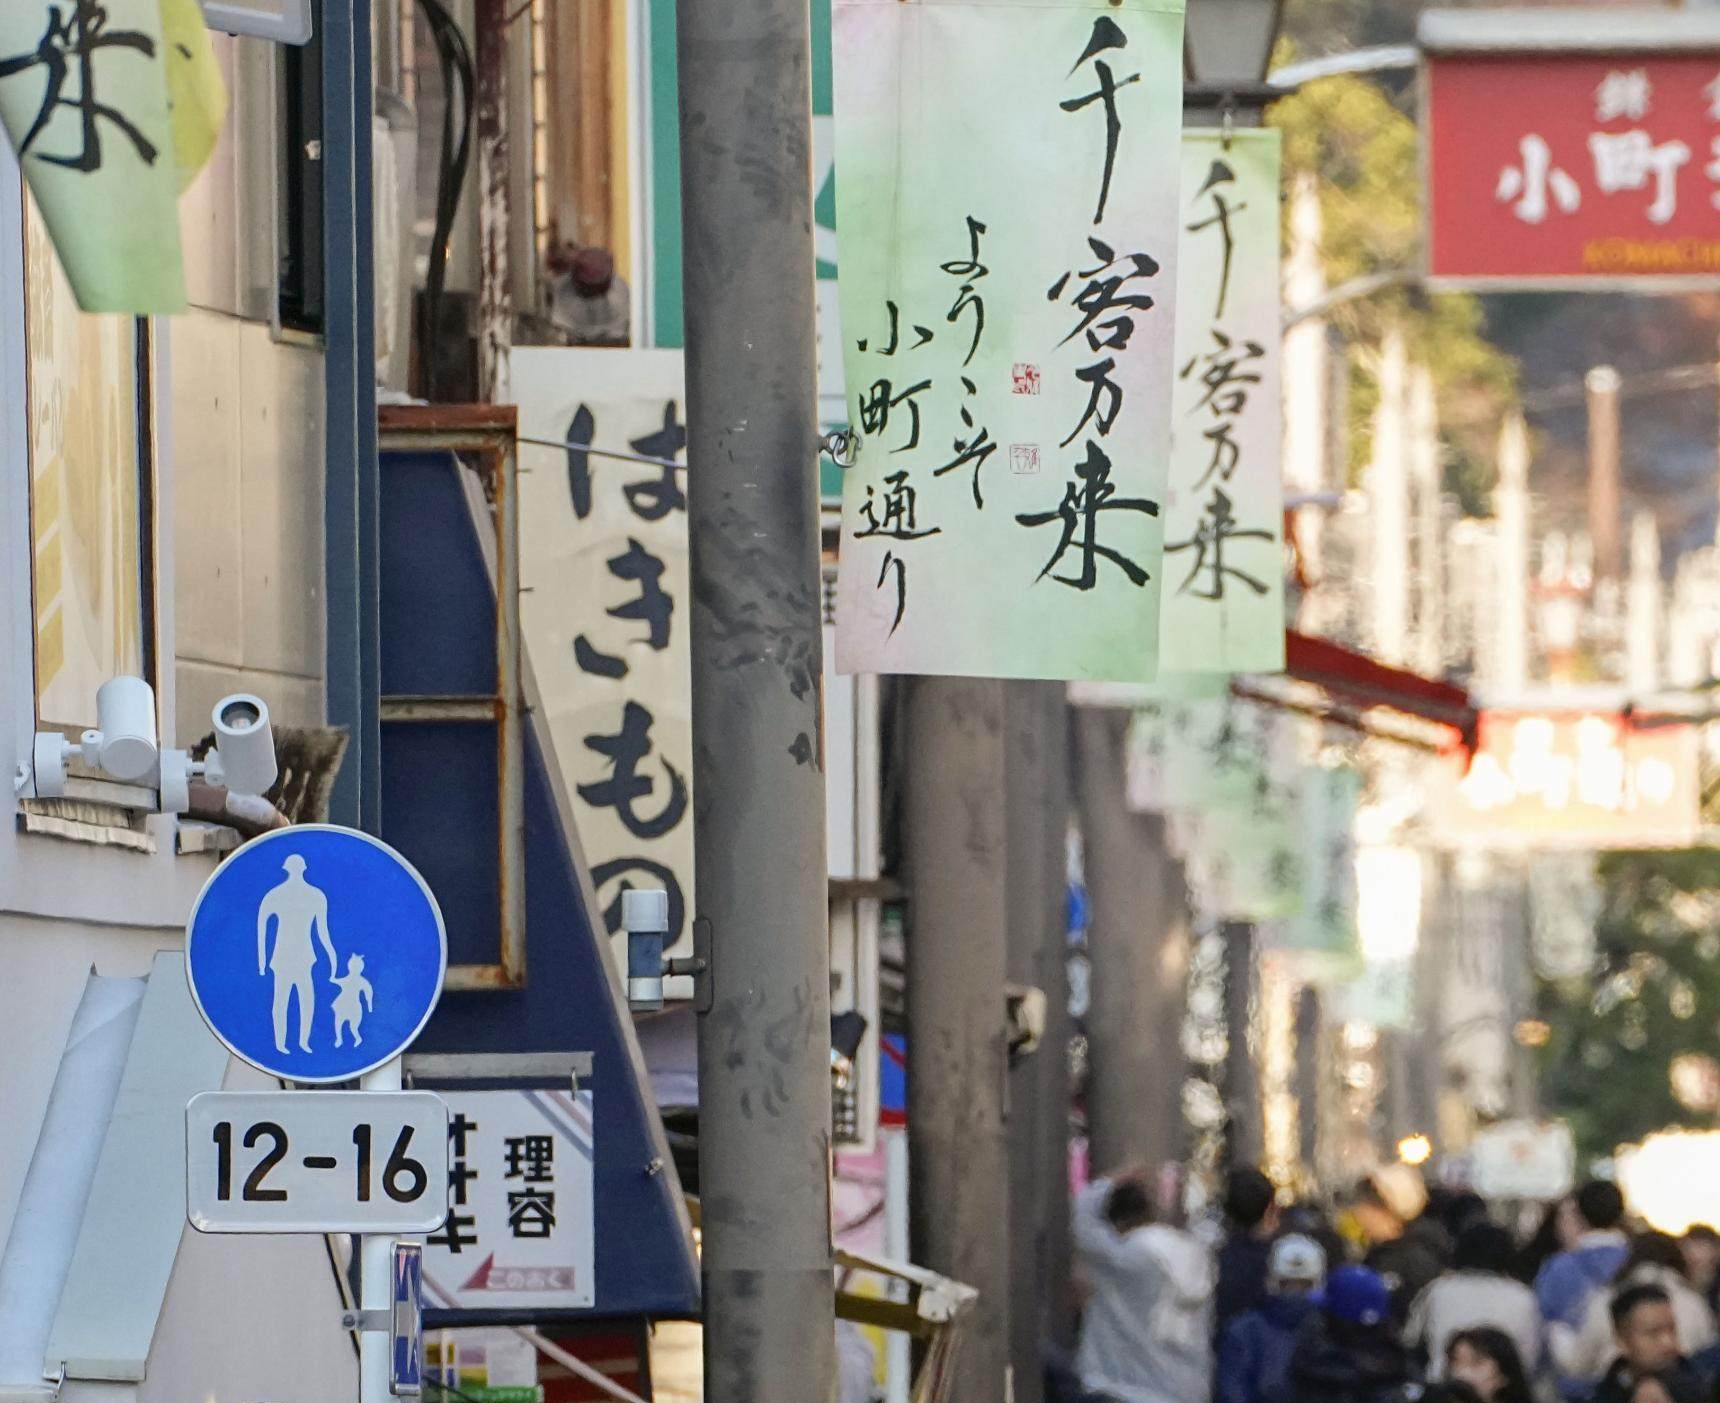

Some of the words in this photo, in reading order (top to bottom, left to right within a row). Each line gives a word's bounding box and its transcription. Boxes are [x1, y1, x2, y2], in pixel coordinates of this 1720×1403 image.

[852, 299, 943, 646] 小町通り
[933, 214, 998, 510] ようこそ
[1016, 15, 1159, 593] 千客万来
[1163, 158, 1276, 602] 千客万来
[566, 397, 690, 950] はきもの
[212, 1120, 428, 1204] 12-16
[504, 1135, 556, 1239] 理容
